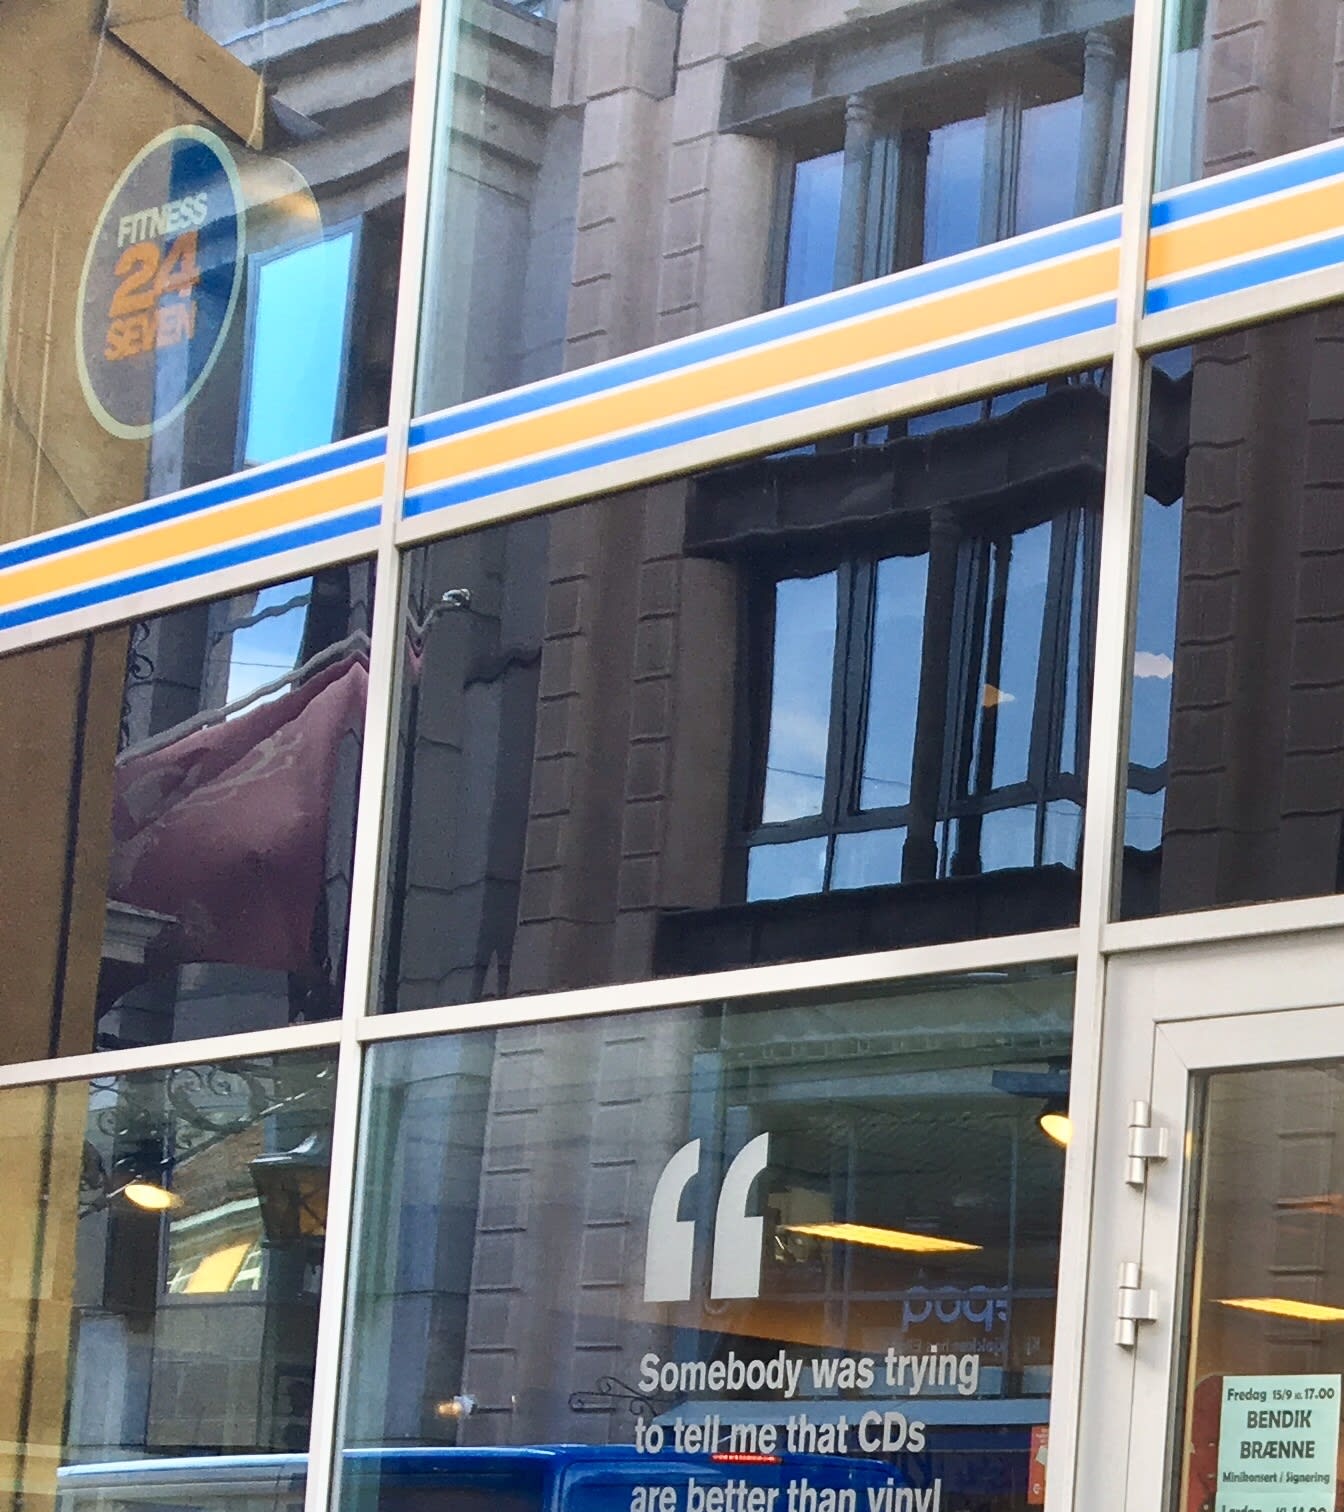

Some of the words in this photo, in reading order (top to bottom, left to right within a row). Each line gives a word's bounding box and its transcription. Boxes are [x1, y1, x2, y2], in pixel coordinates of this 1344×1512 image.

[117, 192, 208, 248] FITNESS
[109, 229, 201, 319] 24
[104, 300, 197, 361] SEVEN
[638, 1350, 802, 1398] Somebody
[812, 1355, 874, 1390] was
[884, 1345, 980, 1396] trying
[1227, 1388, 1267, 1402] Fredag
[1272, 1389, 1292, 1401] 15/9
[1304, 1388, 1335, 1400] 17.00
[634, 1420, 664, 1454] to
[674, 1415, 719, 1453] tell
[729, 1424, 778, 1456] me
[786, 1415, 848, 1454] that
[858, 1411, 926, 1454] CDs
[1246, 1410, 1312, 1429] BENDIK
[1240, 1440, 1315, 1460] BRÆNNE
[1222, 1471, 1278, 1484] Minikonsert
[1286, 1471, 1330, 1485] Signering
